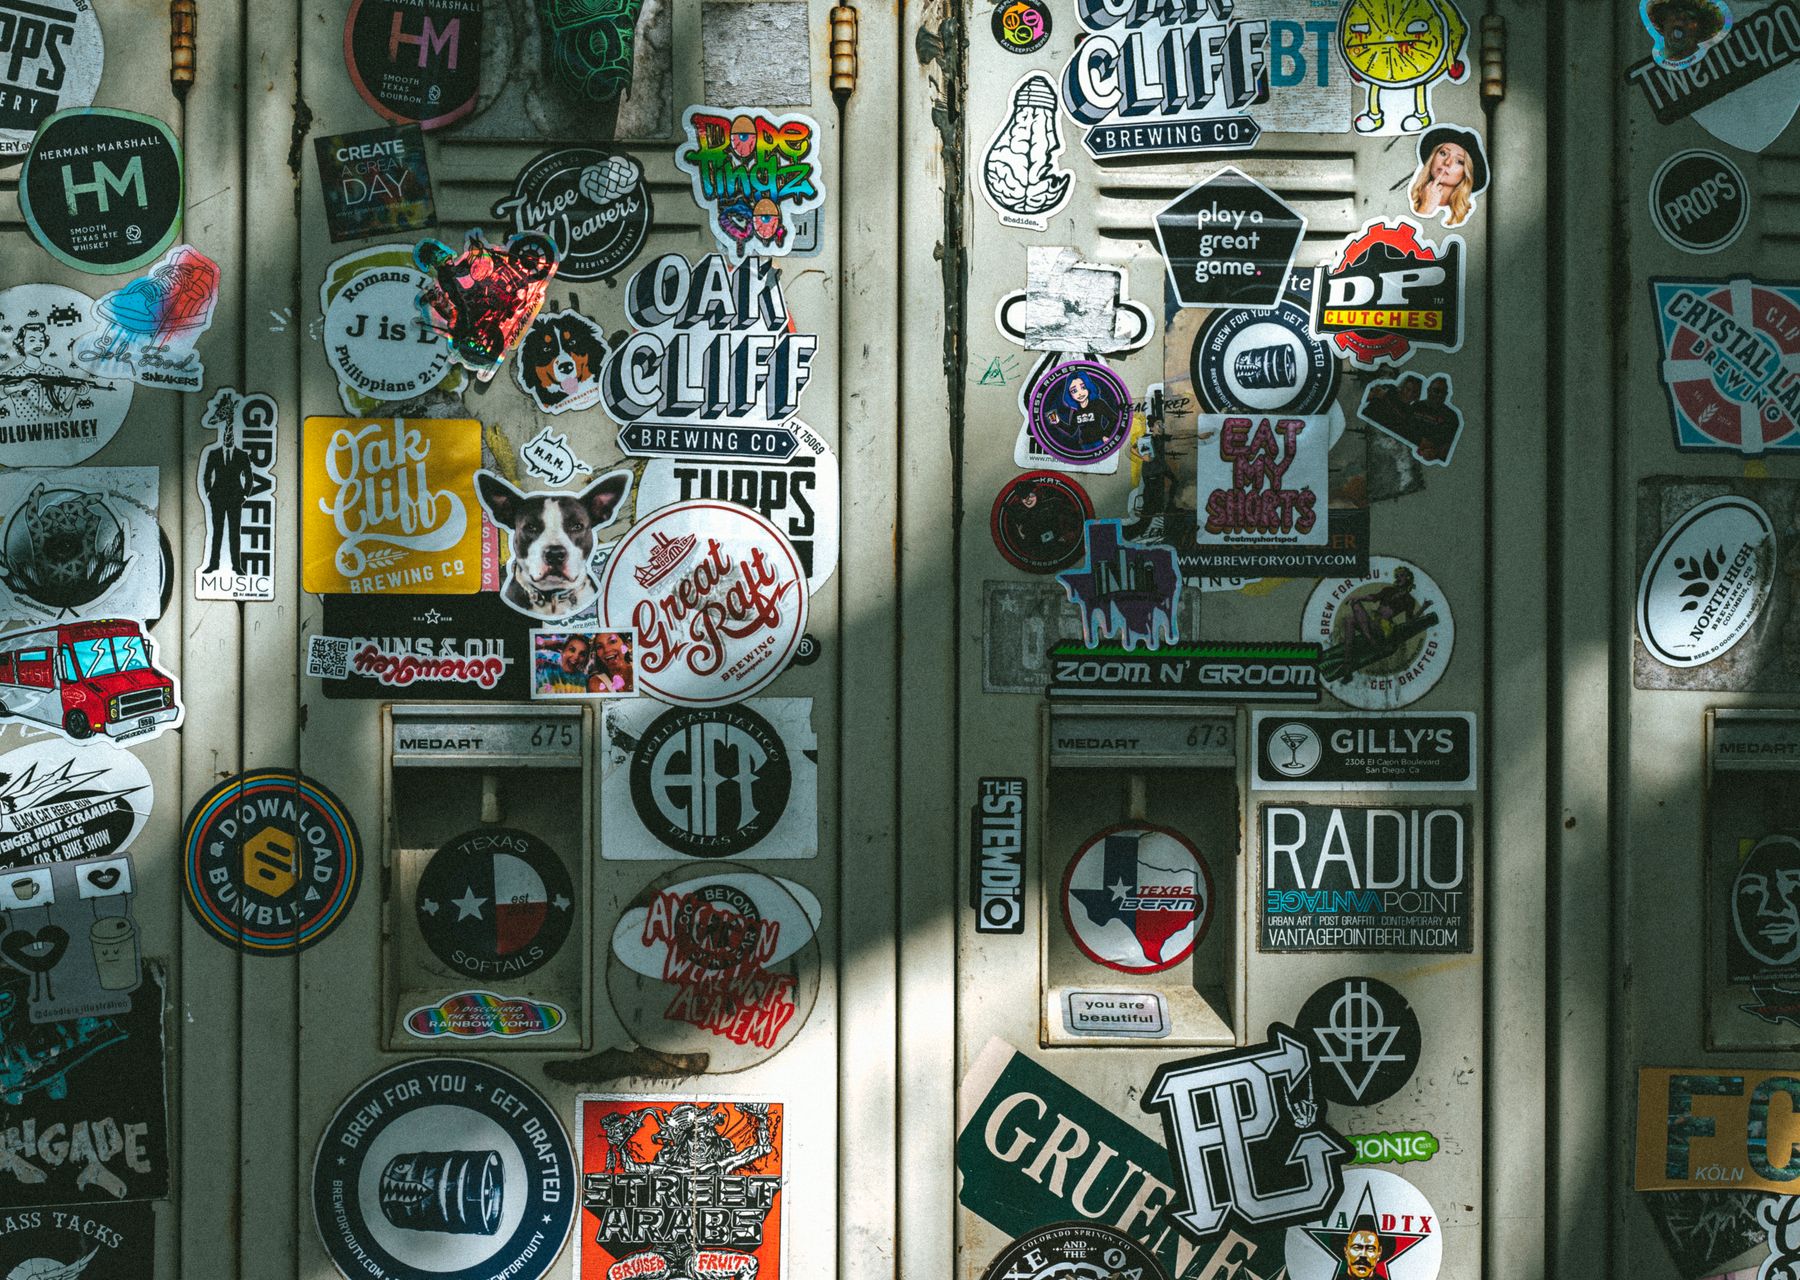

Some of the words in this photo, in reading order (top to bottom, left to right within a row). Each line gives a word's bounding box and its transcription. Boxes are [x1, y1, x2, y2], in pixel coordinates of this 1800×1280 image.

[389, 11, 460, 69] HM
[383, 73, 420, 85] SMOOTH
[1062, 20, 1268, 125] CLIFF
[380, 91, 422, 104] BOURBON
[382, 82, 409, 92] TEXAS
[39, 147, 89, 161] HERMAN
[97, 136, 161, 153] MARSHALL
[1106, 125, 1201, 148] BREWING
[1213, 123, 1239, 141] CO
[336, 139, 405, 163] CREATE
[341, 165, 354, 178] A
[355, 156, 405, 176] GREAT
[61, 155, 148, 216] HM
[342, 170, 409, 206] DAY
[496, 189, 579, 233] Three
[1198, 201, 1245, 230] play
[1250, 210, 1264, 224] a
[1664, 172, 1737, 232] PROPS
[70, 224, 107, 236] SMOOTH
[72, 233, 101, 243] TEXAS
[1200, 231, 1260, 257] great
[1195, 260, 1262, 283] game.
[342, 270, 410, 303] Romans
[630, 253, 788, 329] OAK
[1325, 266, 1446, 306] DP
[346, 314, 369, 338] J
[378, 316, 407, 342] is
[1212, 325, 1231, 351] BREW
[1230, 311, 1249, 329] FOR
[1283, 311, 1303, 325] GET
[1326, 311, 1438, 328] CLUTCHES
[1668, 293, 1771, 378] CRYSTAL
[141, 371, 199, 387] SNEAKERS
[335, 345, 416, 392] Philippians
[418, 353, 449, 384] 2:11
[602, 332, 818, 421] CLIFF
[1690, 340, 1782, 422] BREWING
[325, 418, 431, 485] Oak
[641, 430, 738, 450] BREWING
[750, 434, 776, 452] CO
[801, 430, 825, 455] 75069
[1221, 417, 1306, 462] EAT
[1233, 453, 1295, 492] MY
[319, 462, 467, 551] Cliff
[1205, 488, 1316, 535] SHORTS
[1223, 535, 1298, 543] @eatmyshortspod
[202, 576, 269, 592] MUSIC
[351, 565, 434, 593] BREWING
[1690, 583, 1728, 642] NORTH
[1724, 542, 1755, 587] HIGH
[632, 538, 732, 674] Great
[687, 547, 779, 676] Raft
[1320, 601, 1335, 635] BREW
[1333, 579, 1354, 600] FOR
[1711, 582, 1743, 631] BREWING
[721, 635, 775, 681] BREWING
[1370, 679, 1393, 691] GET
[1400, 641, 1438, 686] DRAFTED
[1056, 661, 1152, 682] ZOOM
[1199, 664, 1317, 686] GROOM
[401, 739, 483, 749] MEDART
[531, 725, 573, 747] 675
[641, 725, 674, 764] HOLD
[676, 711, 720, 728] FAST
[727, 713, 779, 763] TATTOO
[1058, 738, 1140, 749] MEDART
[1187, 725, 1228, 747] 673
[1331, 728, 1454, 754] GILLY'S
[1345, 758, 1365, 766] 2306
[1401, 758, 1440, 766] Boulevard
[983, 781, 1022, 795] THE
[10, 811, 37, 831] BLACK
[36, 807, 53, 822] CAT
[51, 802, 76, 817] REBEL
[75, 798, 93, 809] RUN
[34, 820, 64, 840] HUNT
[64, 799, 119, 828] SCRAMBLE
[21, 848, 28, 857] A
[27, 843, 41, 855] DAY
[41, 838, 52, 849] OF
[52, 826, 85, 845] THIEVING
[62, 840, 85, 861] BIKE
[83, 828, 111, 852] SHOW
[218, 798, 332, 883] DOWNLOAD
[458, 835, 529, 856] TEXAS
[670, 826, 731, 846] DALLAS
[739, 823, 759, 838] TX
[1267, 808, 1464, 889] RADIO
[208, 866, 305, 926] BUMBLE
[511, 893, 530, 904] est
[1119, 897, 1197, 911] BERM
[1138, 886, 1193, 896] TEXAS
[1384, 891, 1463, 913] POINT
[1268, 915, 1294, 926] URBAN
[1297, 915, 1312, 926] ART
[1319, 915, 1338, 926] POST
[1341, 915, 1375, 926] GRAFFITI
[1381, 915, 1444, 926] CONTEMPORARY
[1446, 915, 1461, 926] ART
[1268, 928, 1458, 946] VANTAGEPOINTBERLIN.COM
[452, 946, 544, 974] SOFTAILS
[1079, 1012, 1154, 1024] beautiful
[1085, 1000, 1117, 1011] you
[1119, 1001, 1145, 1011] are
[428, 1020, 498, 1028] RAINBOW
[500, 1020, 543, 1028] VOMIT
[341, 1100, 384, 1149] BREW
[383, 1078, 423, 1108] FOR
[427, 1074, 467, 1093] YOU
[490, 1087, 529, 1119] GET
[522, 1116, 561, 1203] DRAFTED
[1696, 1163, 1745, 1182] KÖLN
[583, 1173, 782, 1208] STREET
[53, 1211, 124, 1249] TACKS
[332, 1179, 385, 1278] BREWFORYOUTV.COM
[596, 1207, 765, 1246] ARABS
[1381, 1213, 1433, 1233] DTX
[1022, 1229, 1071, 1251] COLORADO
[1119, 1242, 1131, 1251] CO
[1063, 1240, 1088, 1249] AND
[1064, 1250, 1087, 1258] THE
[610, 1252, 665, 1280] BRUISED
[698, 1253, 749, 1273] FRUIT
